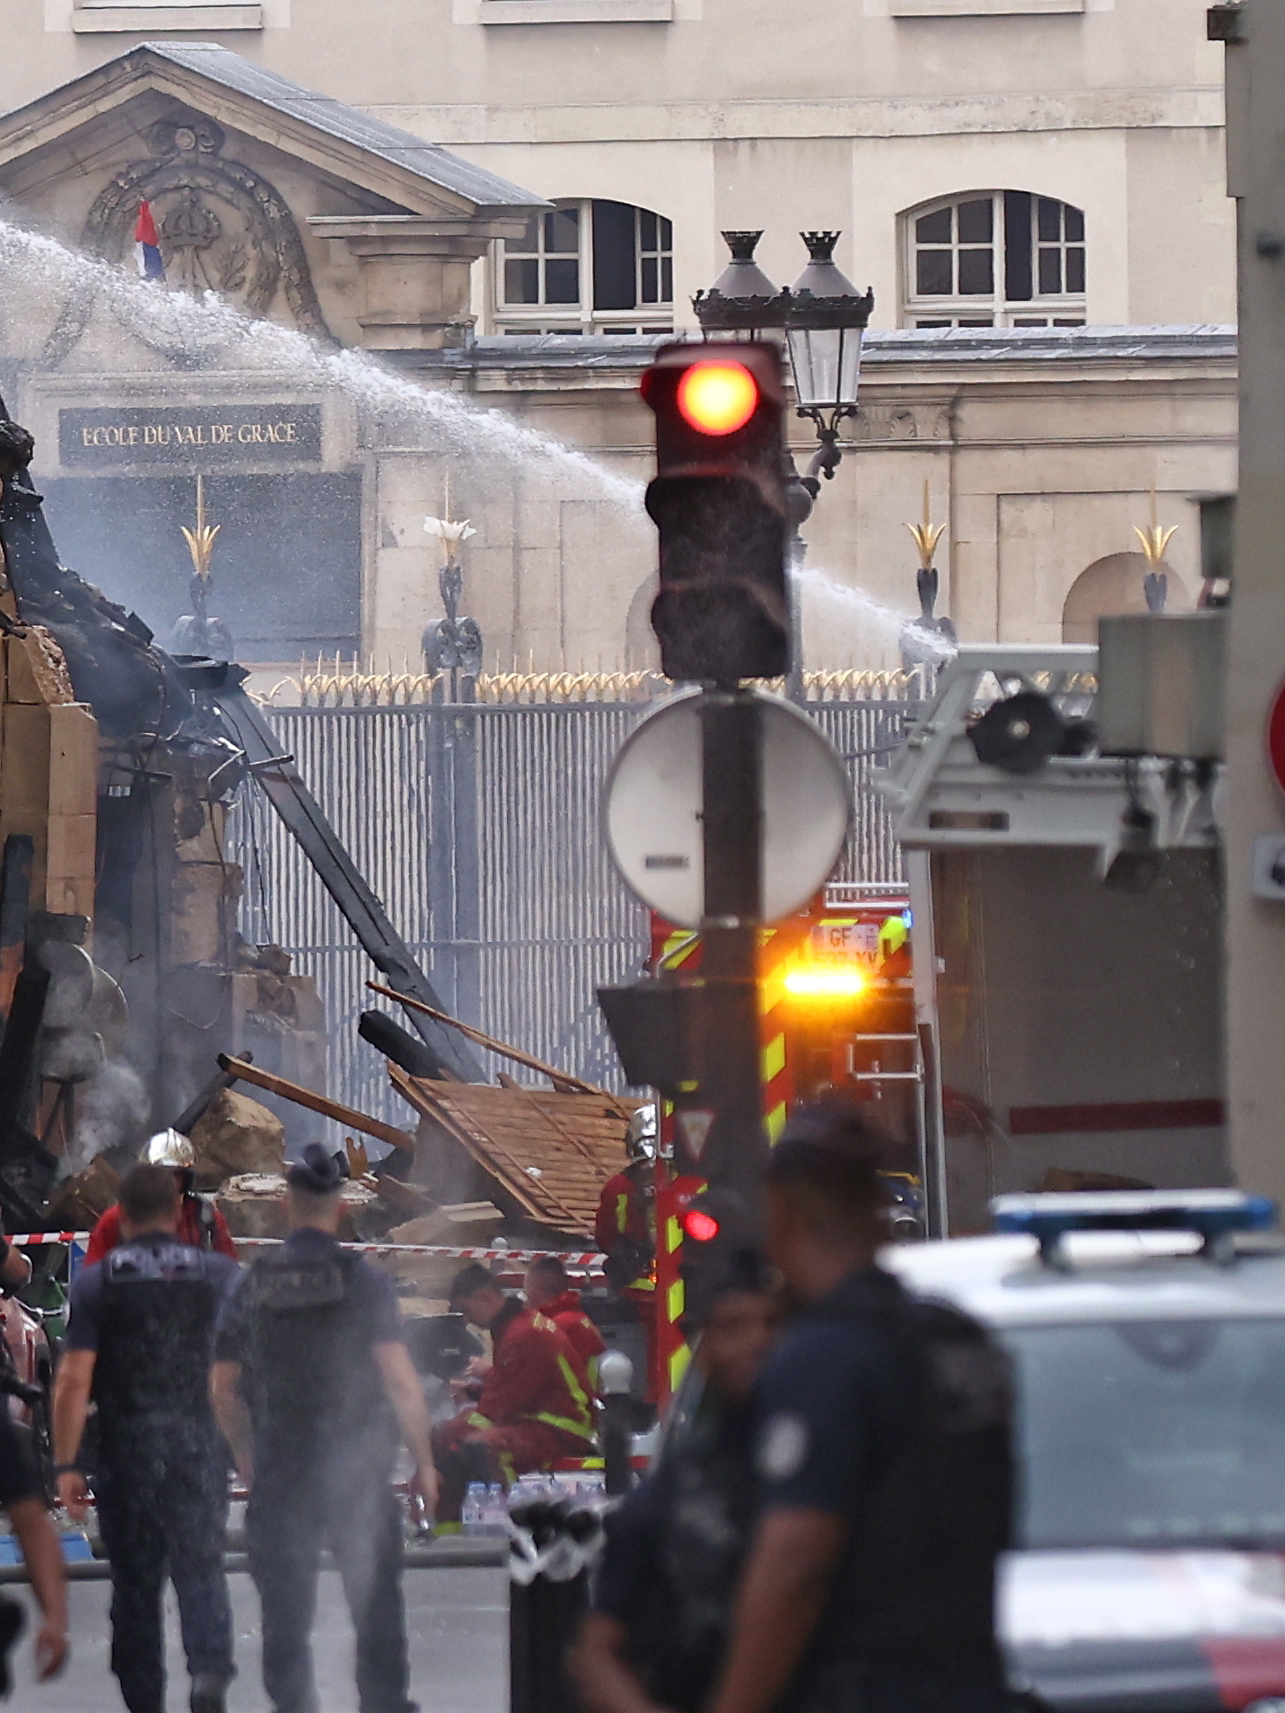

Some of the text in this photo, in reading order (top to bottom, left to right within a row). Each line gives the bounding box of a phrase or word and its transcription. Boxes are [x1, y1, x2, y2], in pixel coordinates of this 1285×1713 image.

[82, 427, 138, 446] ECOLE
[144, 425, 169, 445] DU
[174, 424, 207, 445] VAL
[211, 424, 234, 444] DE
